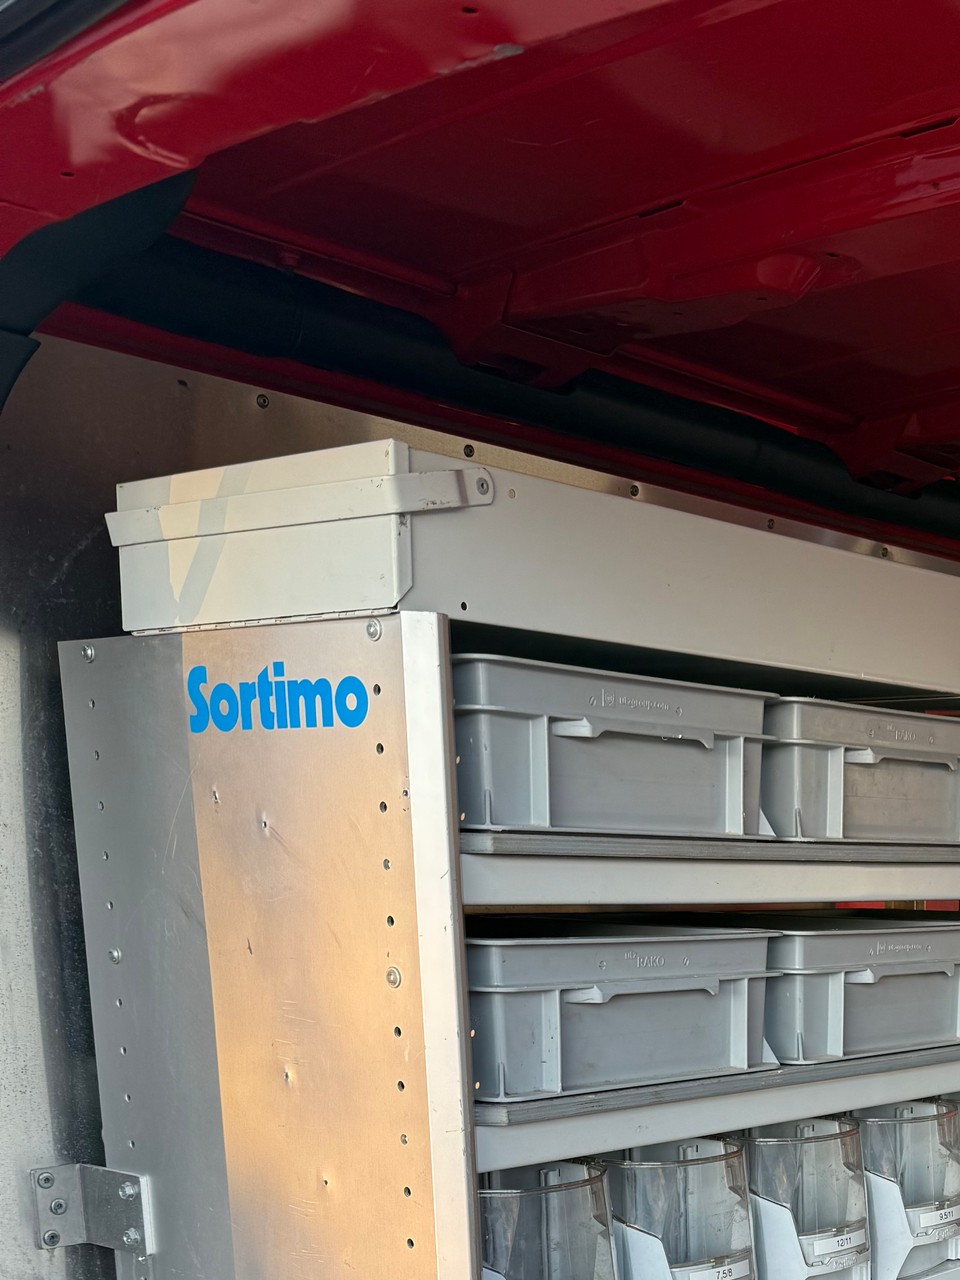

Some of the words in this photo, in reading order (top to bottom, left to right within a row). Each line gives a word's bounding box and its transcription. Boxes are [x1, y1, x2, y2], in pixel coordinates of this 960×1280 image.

[187, 661, 369, 734] Sortimo
[636, 956, 665, 968] RAKO
[836, 1237, 852, 1247] 12/11
[715, 1268, 733, 1280] 7,5/8
